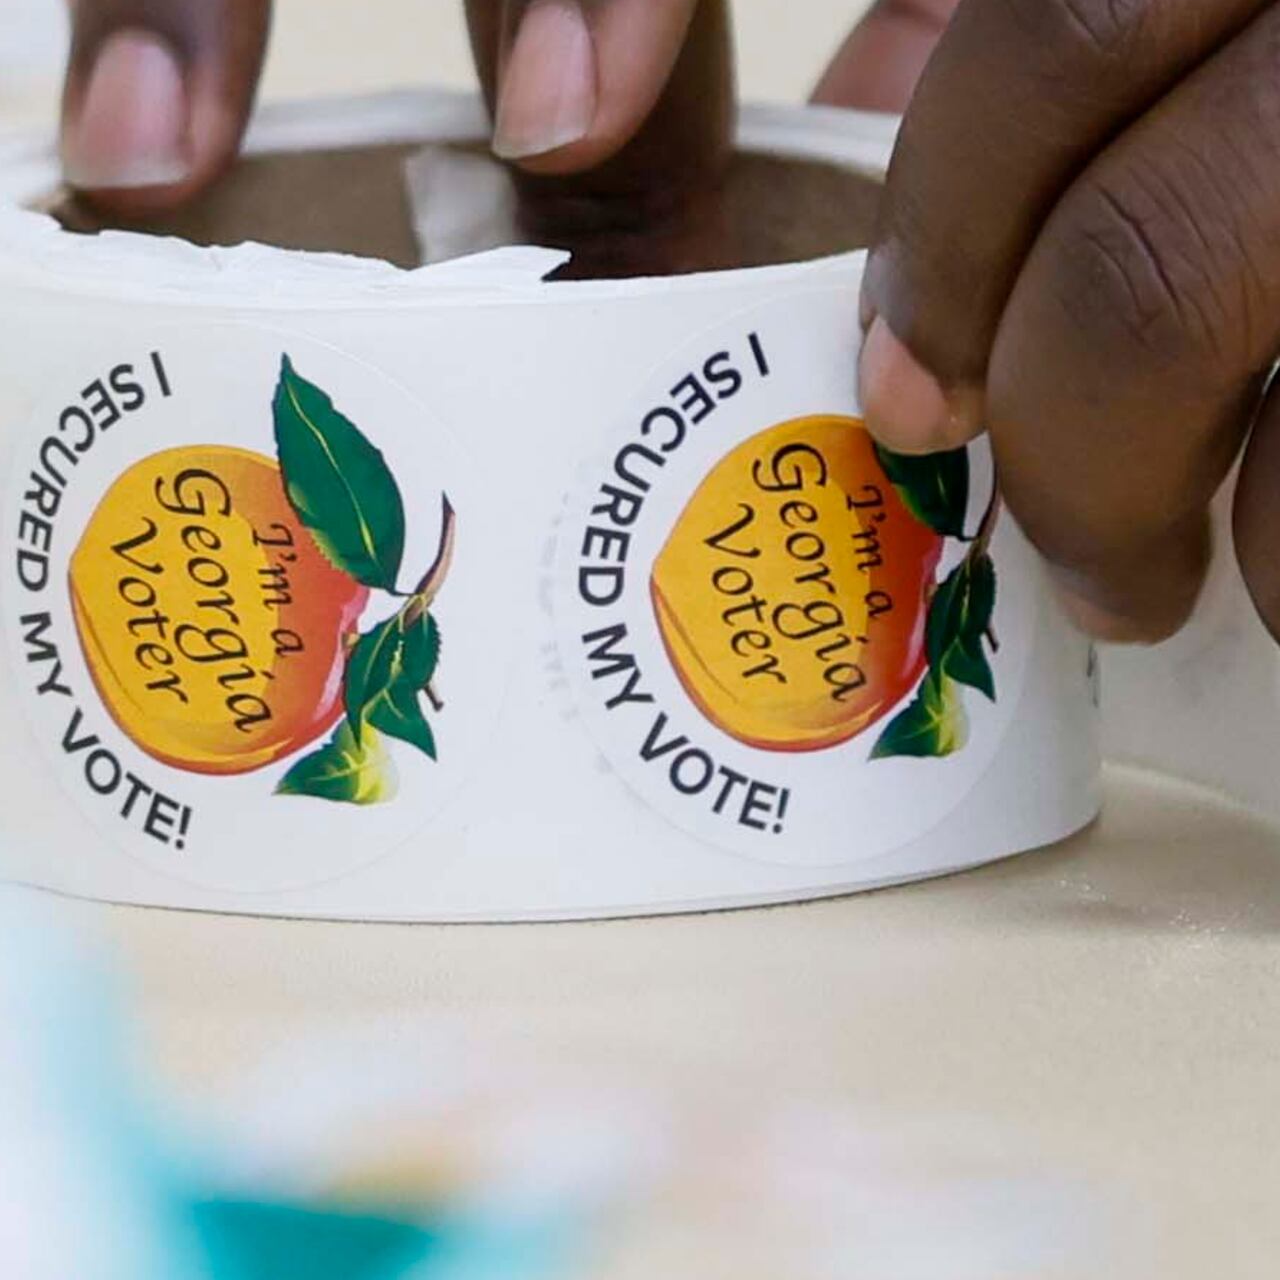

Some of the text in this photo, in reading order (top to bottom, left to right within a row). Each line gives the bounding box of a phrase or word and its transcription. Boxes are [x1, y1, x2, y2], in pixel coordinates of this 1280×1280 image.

[17, 351, 193, 851] I SECURED MY VOTE!
[110, 517, 189, 706] Voter
[155, 468, 276, 734] Georgia
[252, 522, 305, 657] I'm a
[578, 332, 791, 834] I SECURED MY VOTE!
[703, 502, 787, 687] Voter
[752, 441, 869, 703] Georgia
[846, 484, 894, 619] I'm a
